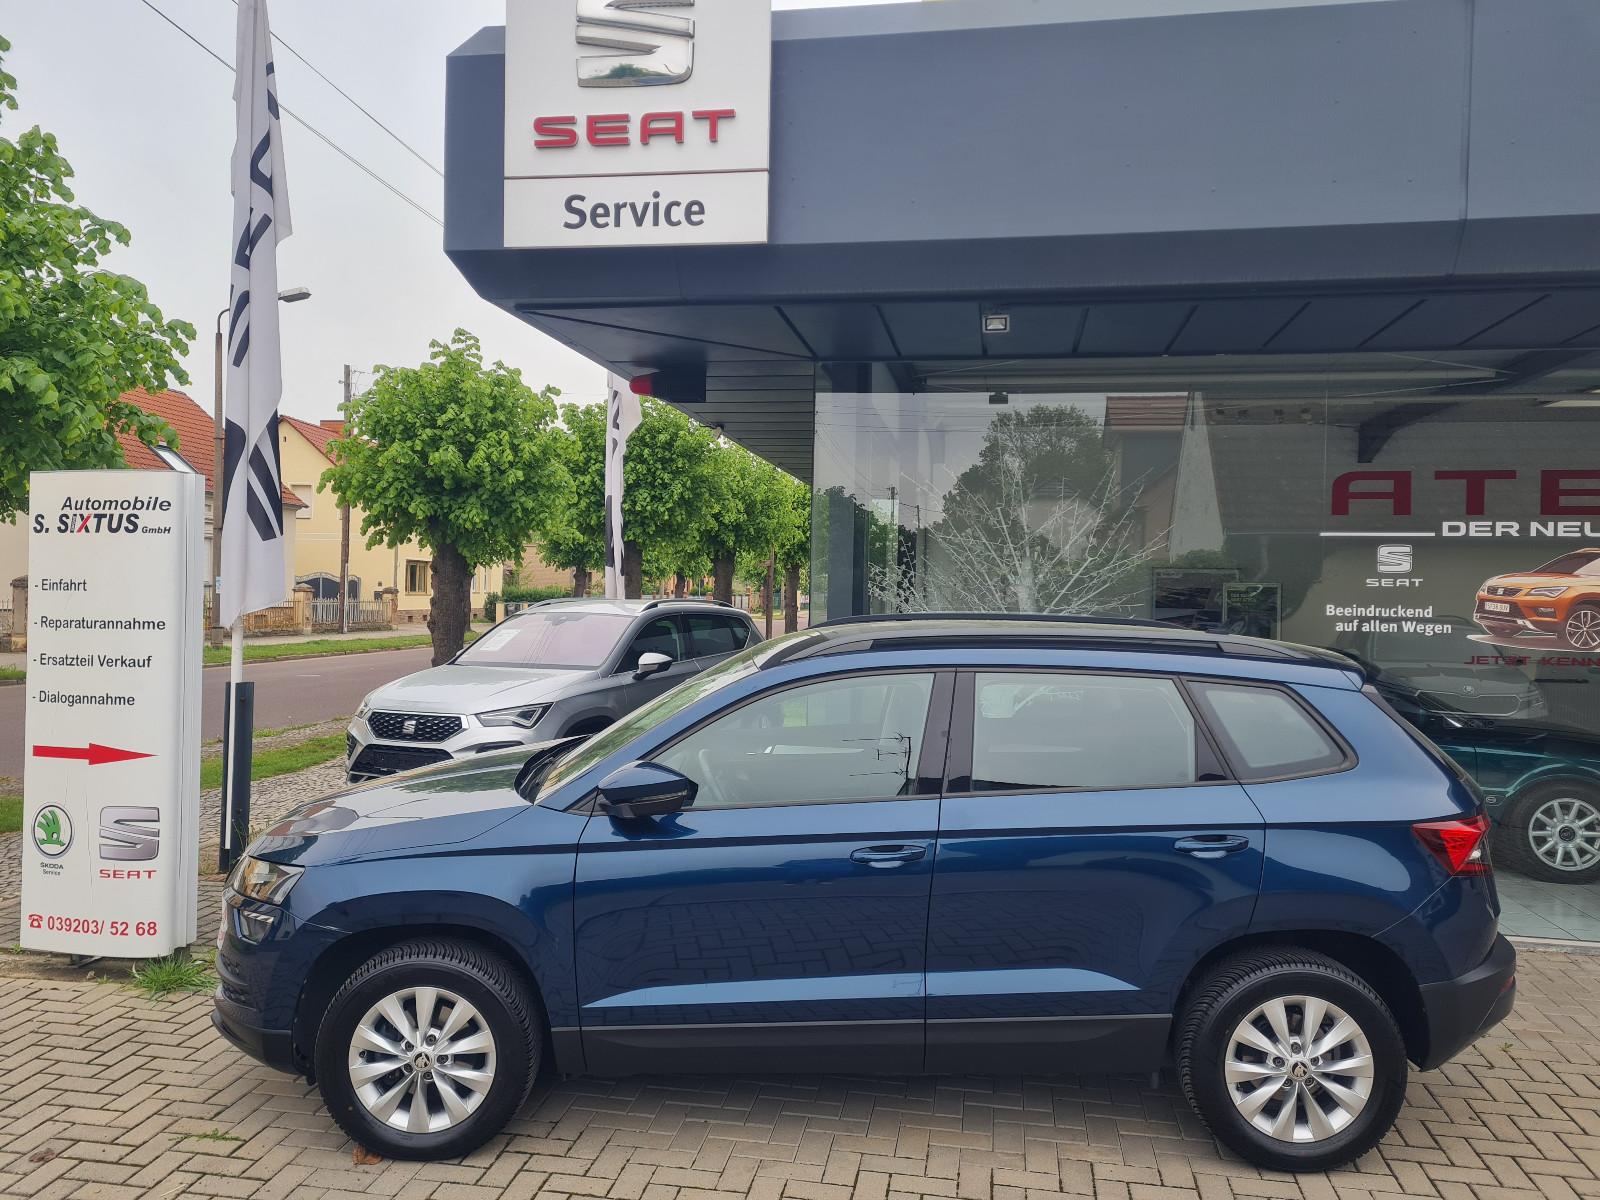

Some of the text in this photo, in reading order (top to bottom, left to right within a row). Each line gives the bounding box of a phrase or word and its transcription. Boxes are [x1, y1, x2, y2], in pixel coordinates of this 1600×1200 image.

[533, 109, 737, 148] SEAT
[563, 190, 706, 230] Service
[61, 496, 172, 511] Automobile
[33, 513, 50, 534] S.
[141, 526, 172, 535] GmbH
[1442, 521, 1520, 537] DER
[41, 578, 88, 592] Einfahrt
[1366, 578, 1424, 587] SEAT
[1326, 604, 1433, 618] Beeindruckend
[40, 615, 166, 631] Reparaturannahme
[1336, 619, 1452, 636] auf allen Wegen
[39, 653, 94, 667] Ersatzteil
[97, 654, 153, 668] Verkauf
[39, 690, 136, 707] Dialogannahme
[99, 869, 157, 879] SEAT
[47, 915, 158, 936] 039203/ 52 68
